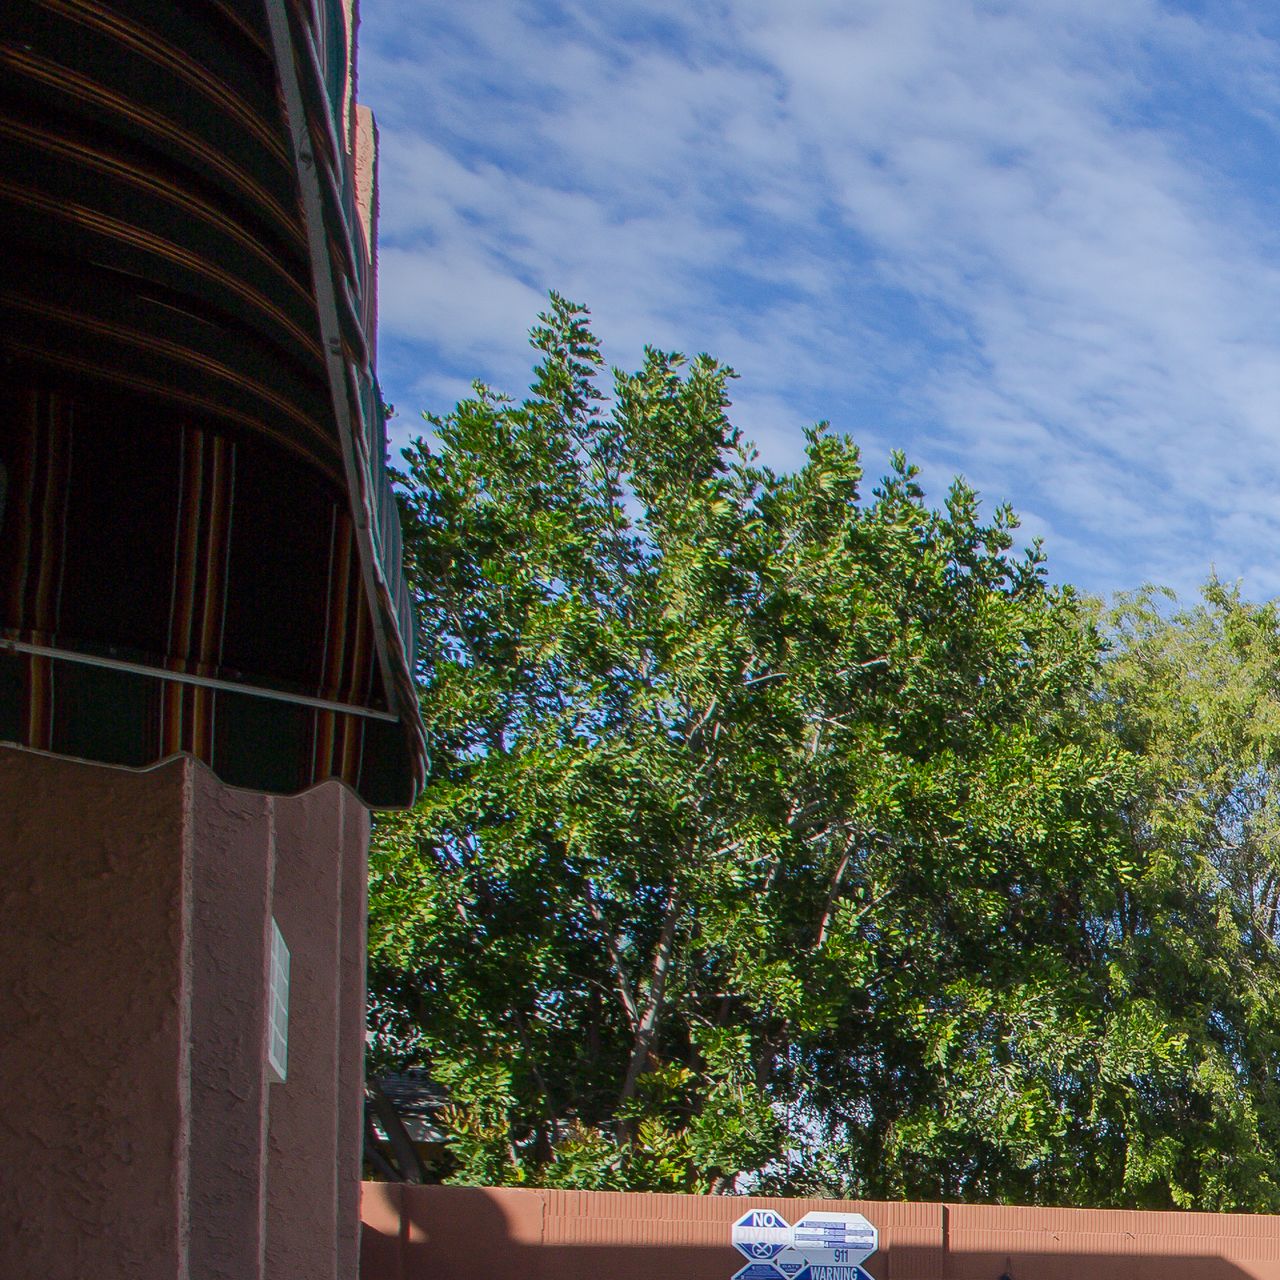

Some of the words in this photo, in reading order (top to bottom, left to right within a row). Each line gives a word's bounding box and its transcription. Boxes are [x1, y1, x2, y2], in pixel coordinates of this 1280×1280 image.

[753, 1212, 776, 1227] NO
[735, 1228, 790, 1242] DIVING
[834, 1248, 848, 1262] 911
[810, 1266, 858, 1280] WARNING
